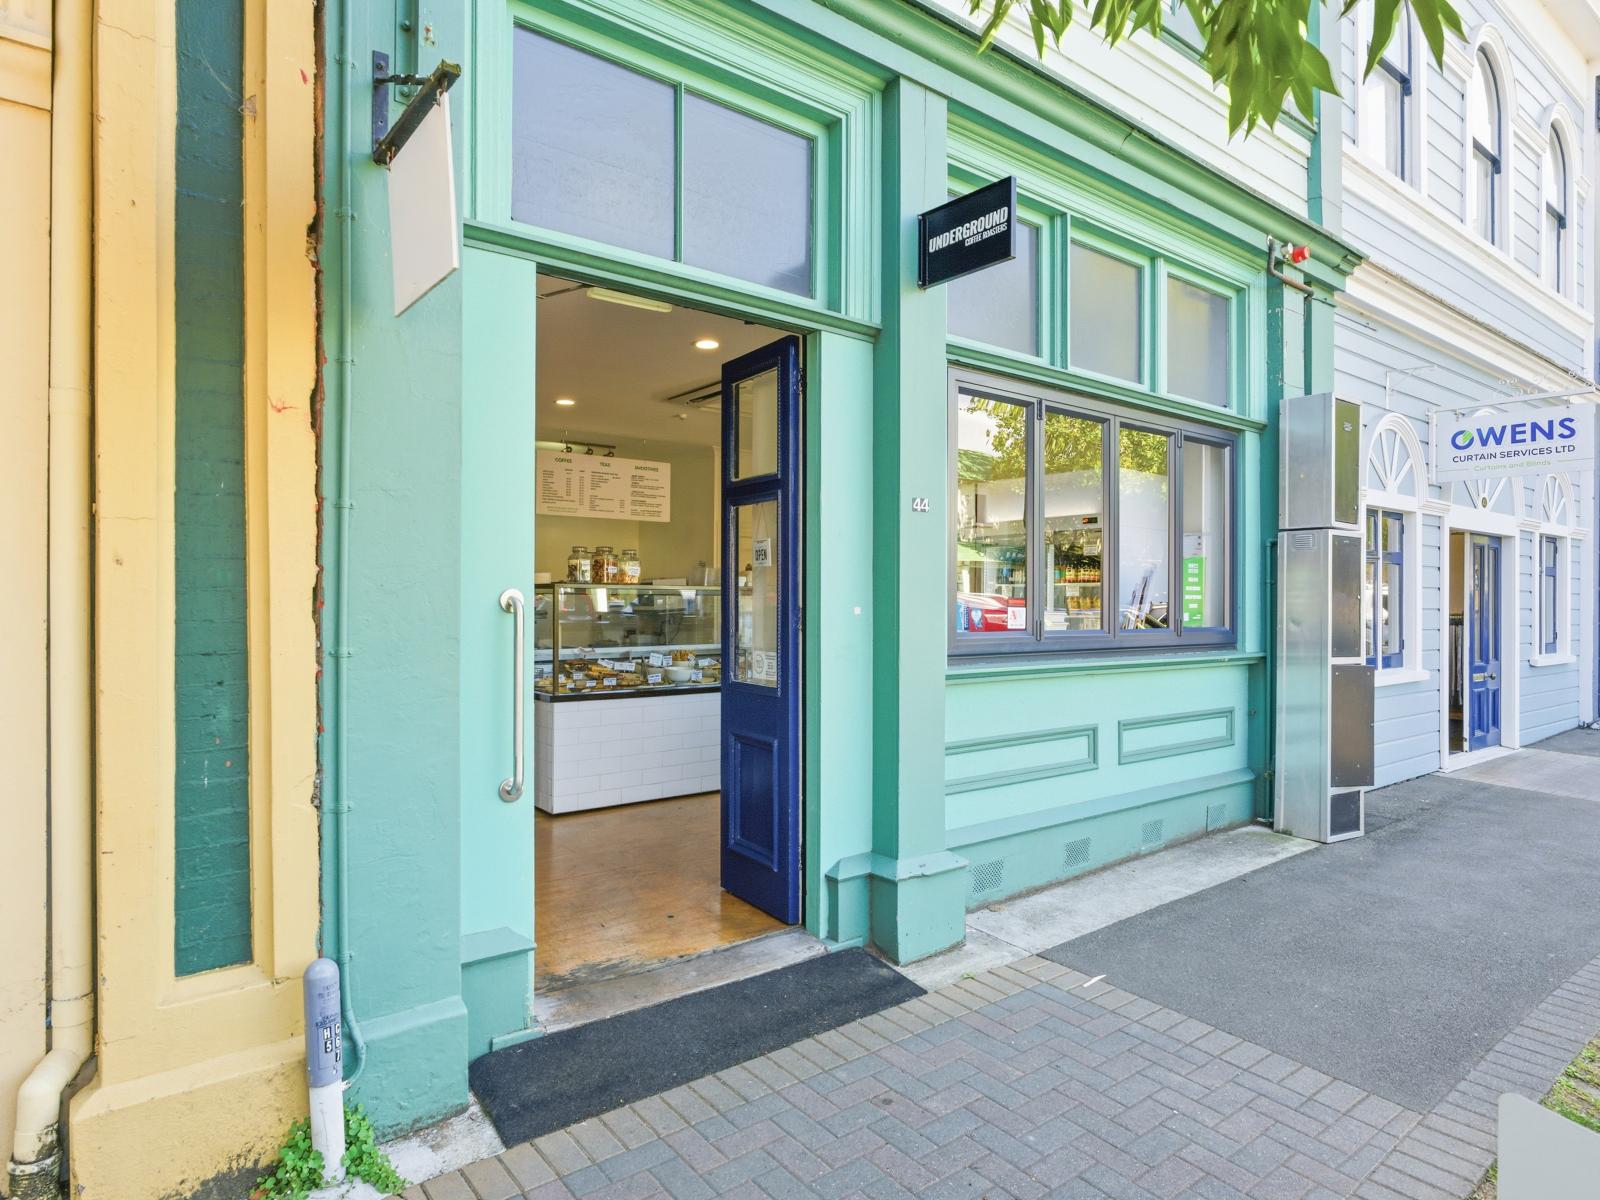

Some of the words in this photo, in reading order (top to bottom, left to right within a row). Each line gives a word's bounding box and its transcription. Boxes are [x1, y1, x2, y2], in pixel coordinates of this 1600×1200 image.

[928, 206, 1009, 254] UNDERGROUND
[964, 232, 983, 247] COFFEE
[1450, 417, 1576, 451] OWENS
[1452, 452, 1497, 464] CURTAIN
[1499, 446, 1553, 459] SERVICES
[1555, 444, 1576, 454] LTD
[1508, 461, 1525, 469] and
[912, 497, 929, 512] 44
[754, 549, 768, 562] OPEN
